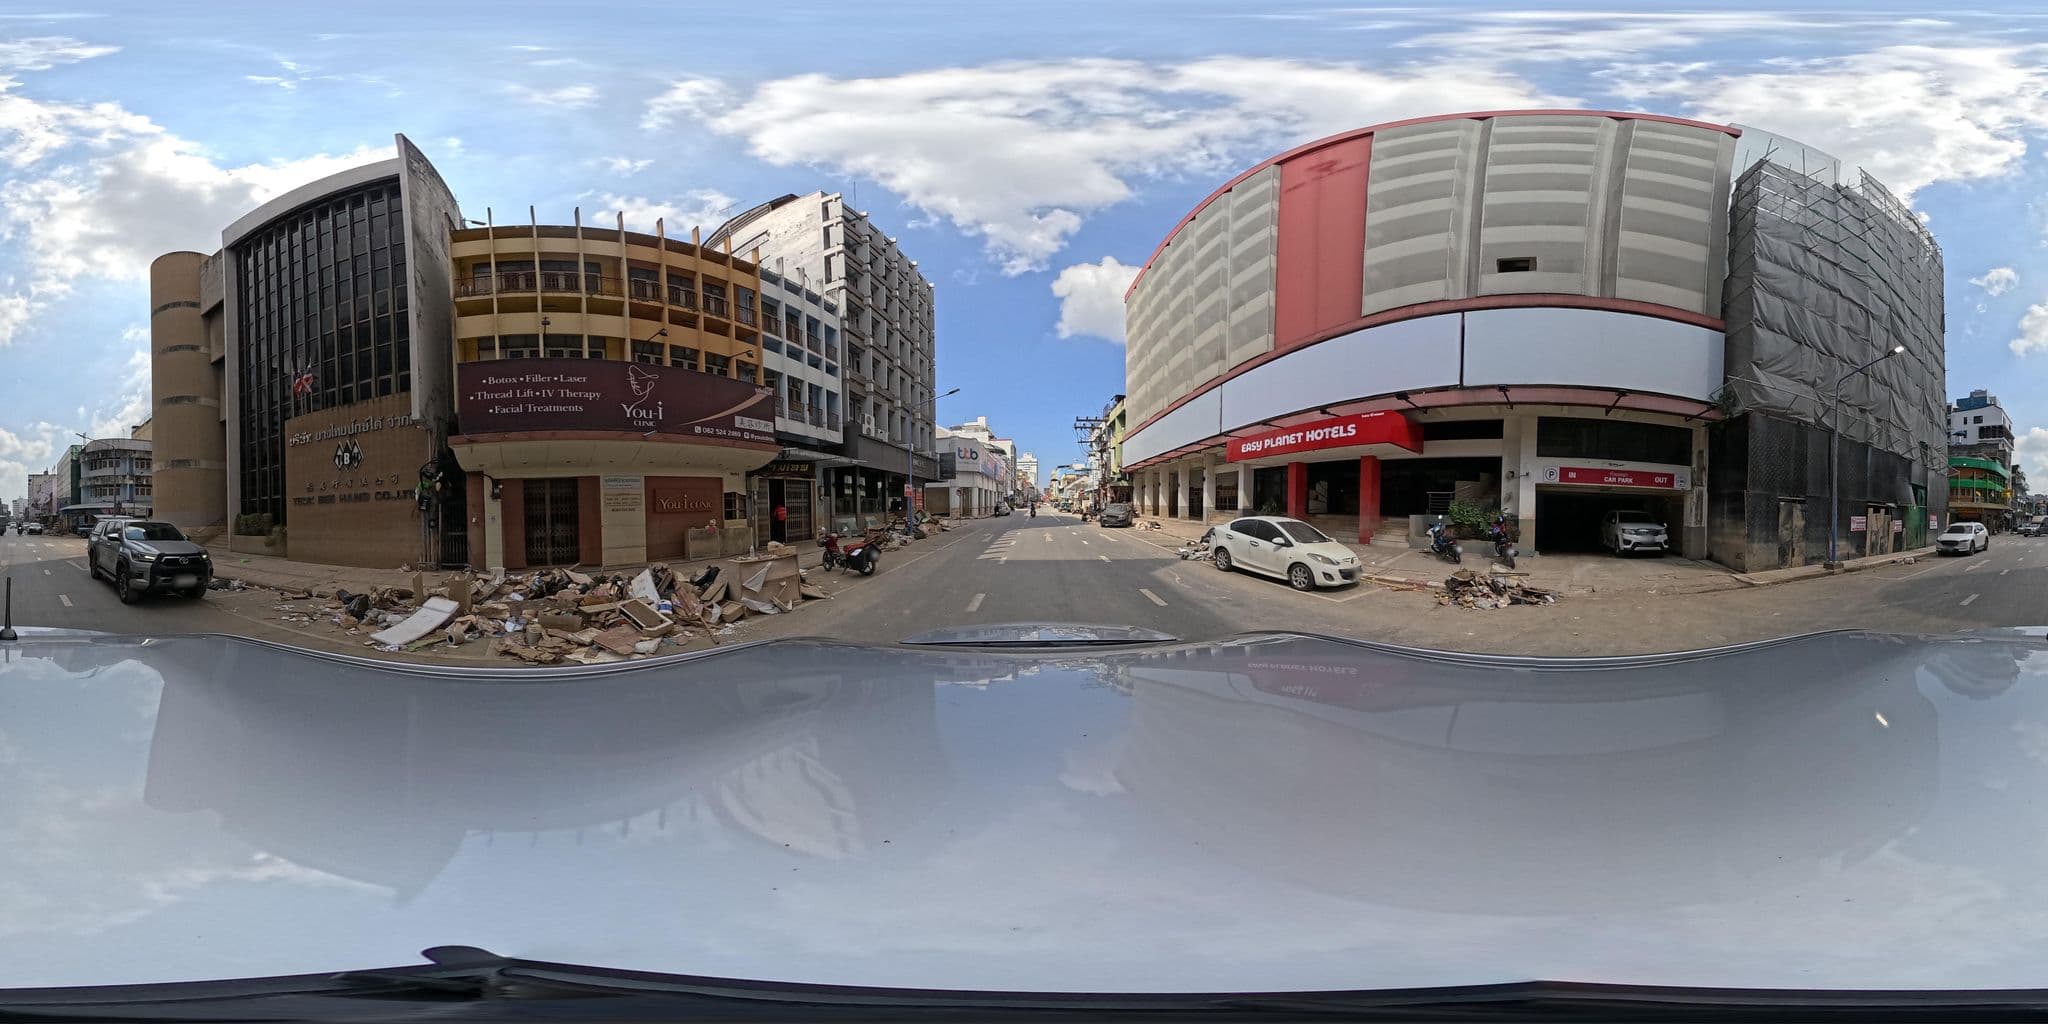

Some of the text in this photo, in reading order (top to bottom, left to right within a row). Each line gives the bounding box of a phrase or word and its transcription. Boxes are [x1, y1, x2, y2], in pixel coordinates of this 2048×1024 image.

[488, 374, 588, 385] Botox Filler Laser
[475, 389, 601, 401] Thread Lift IV Therapy
[495, 403, 584, 414] Facial Treatments
[633, 419, 656, 427] CLINIC
[1241, 424, 1357, 453] EASY PLANET HOTELS
[957, 447, 979, 461] ttb
[1568, 471, 1576, 479] IN
